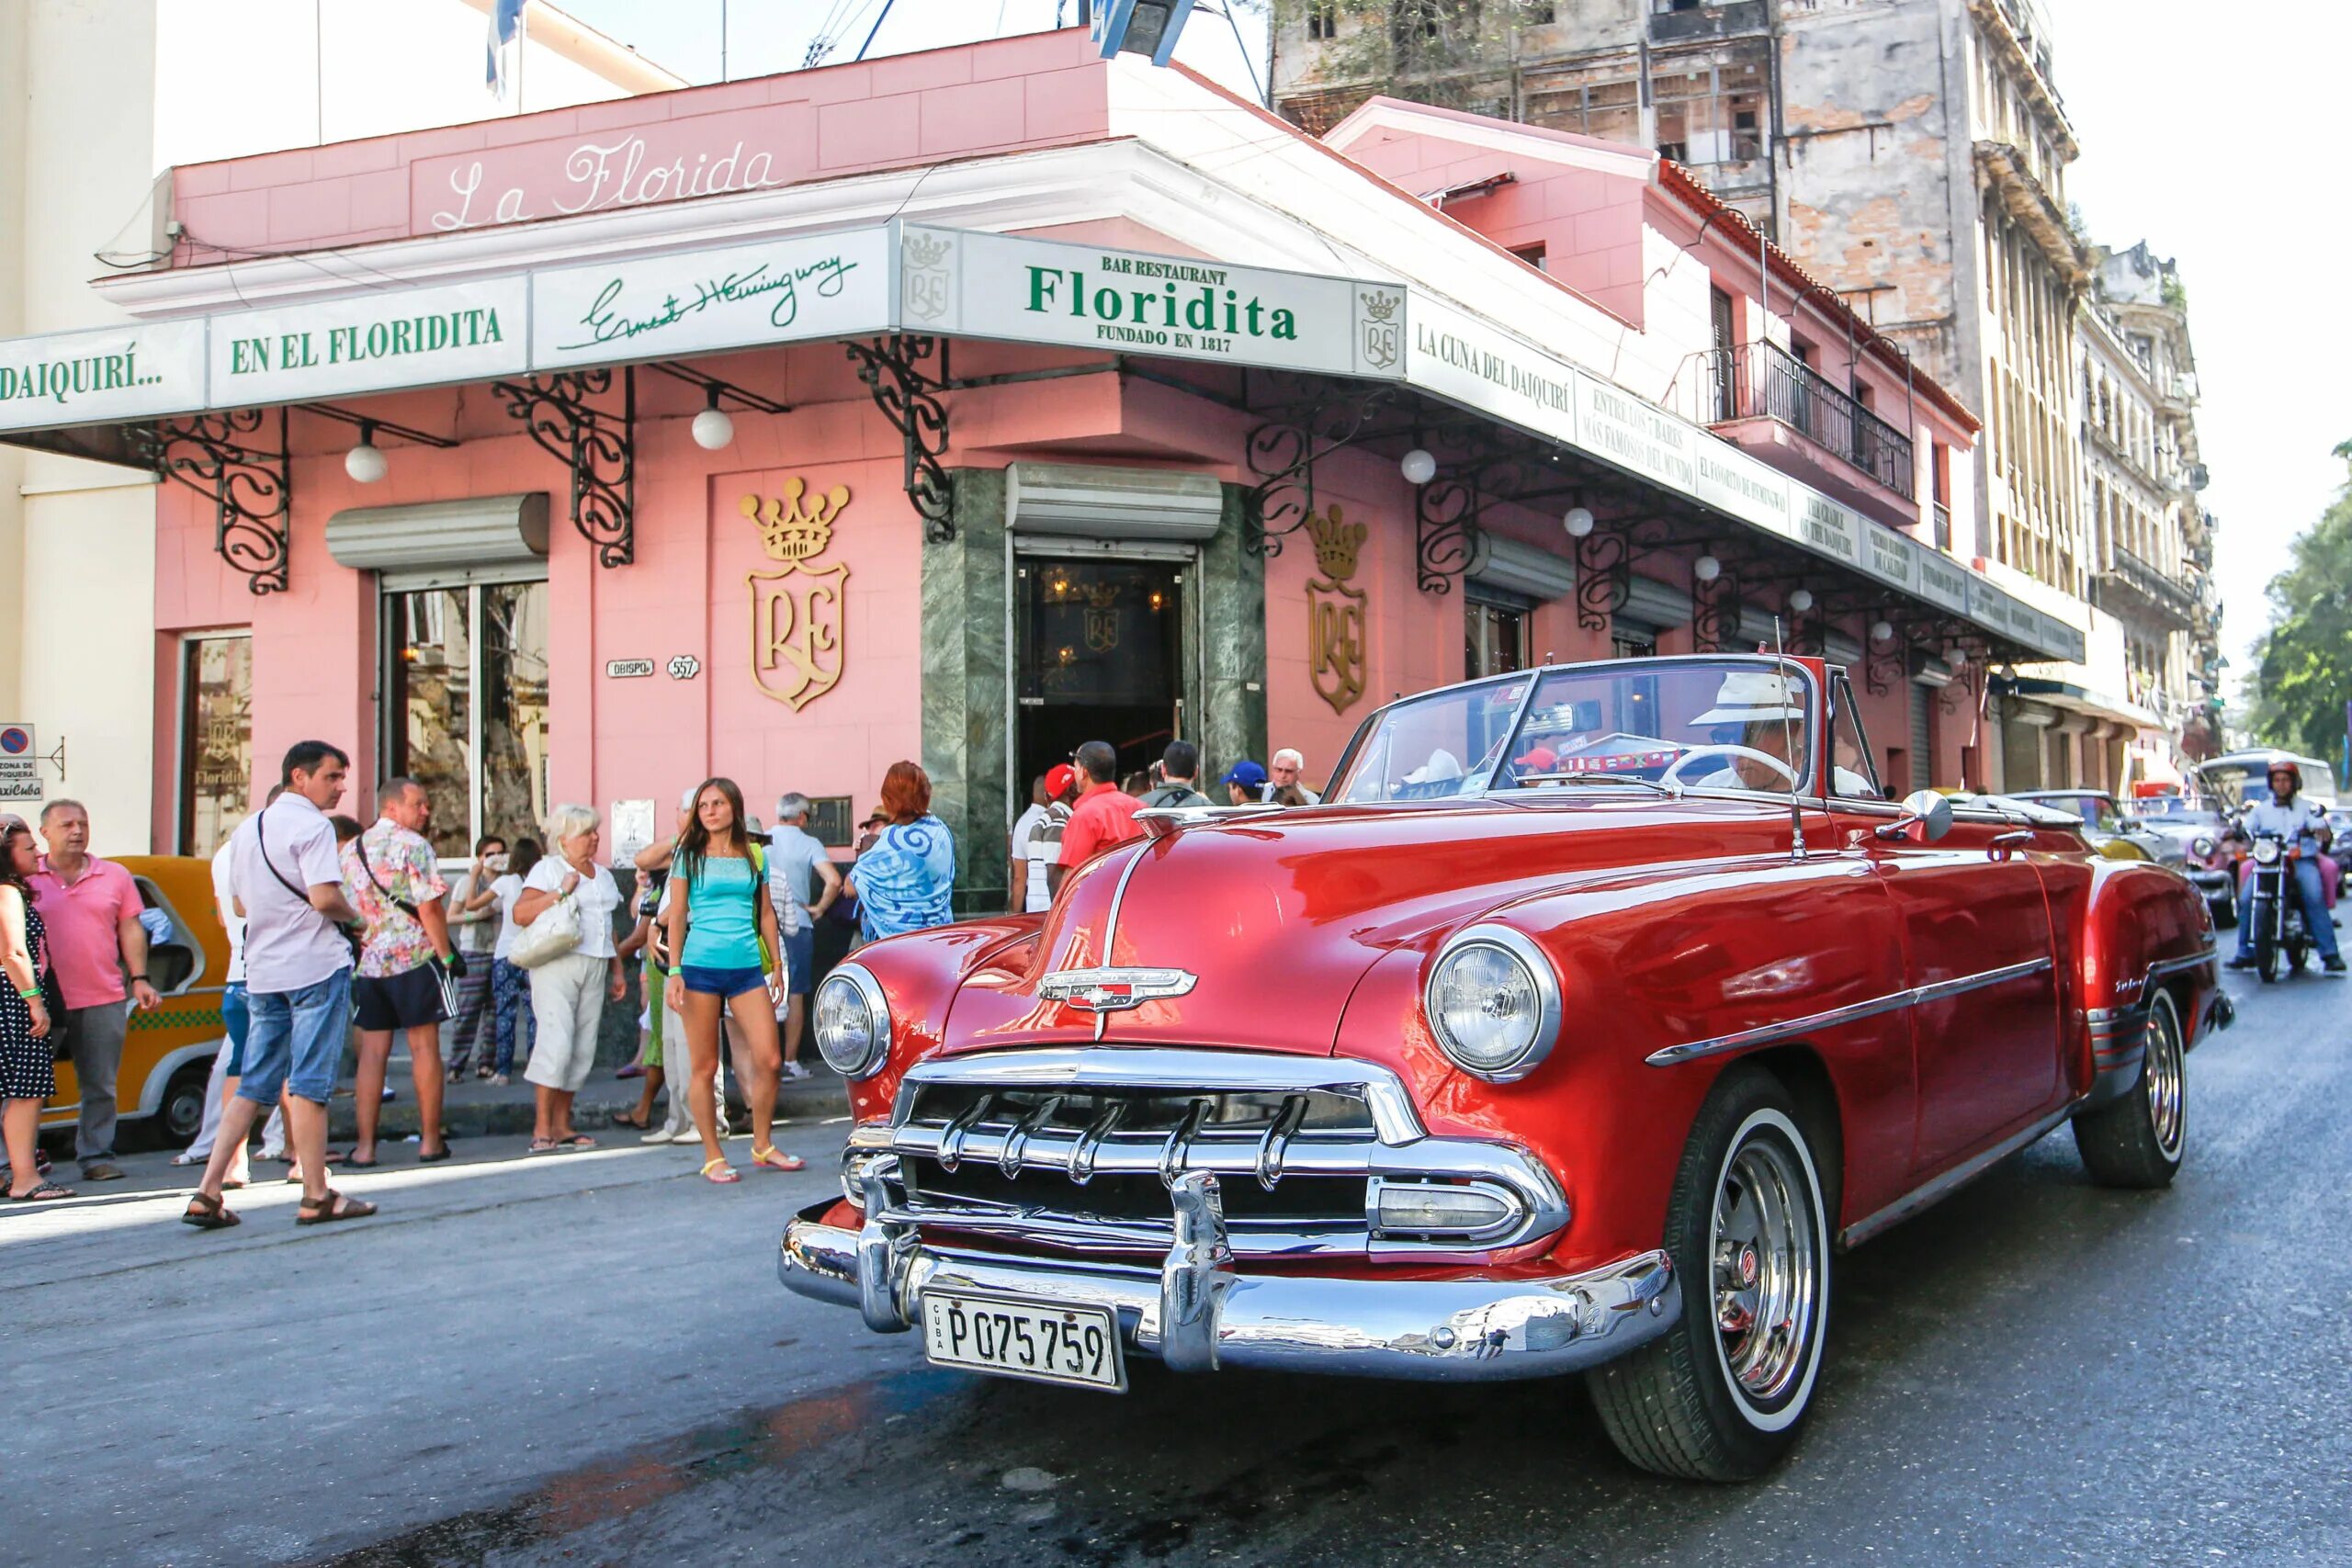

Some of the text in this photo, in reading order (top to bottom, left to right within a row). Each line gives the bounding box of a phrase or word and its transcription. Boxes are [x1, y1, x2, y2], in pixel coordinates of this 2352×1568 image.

[432, 133, 783, 231] La Florida
[1102, 256, 1227, 286] BAR RESTAURANT
[1024, 265, 1298, 342] Floridita
[231, 308, 503, 375] EN EL FLORIDITA
[1097, 324, 1231, 354] FUNDADO EN 1817
[1418, 323, 1569, 414] LA CUNA DEL DAIQUIRÍ
[1594, 389, 1627, 424] ENTRE
[1629, 405, 1646, 434] LOS
[1655, 419, 1683, 450] BARES
[1583, 411, 1693, 486] MÁS FAMOSOS DEL MUNDO
[1701, 457, 1710, 479] EL
[1711, 461, 1741, 493] FAVORITO
[614, 662, 647, 675] OBISPO
[673, 660, 694, 675] 557
[0, 784, 40, 796] axiCuba
[933, 1304, 944, 1349] CUBA
